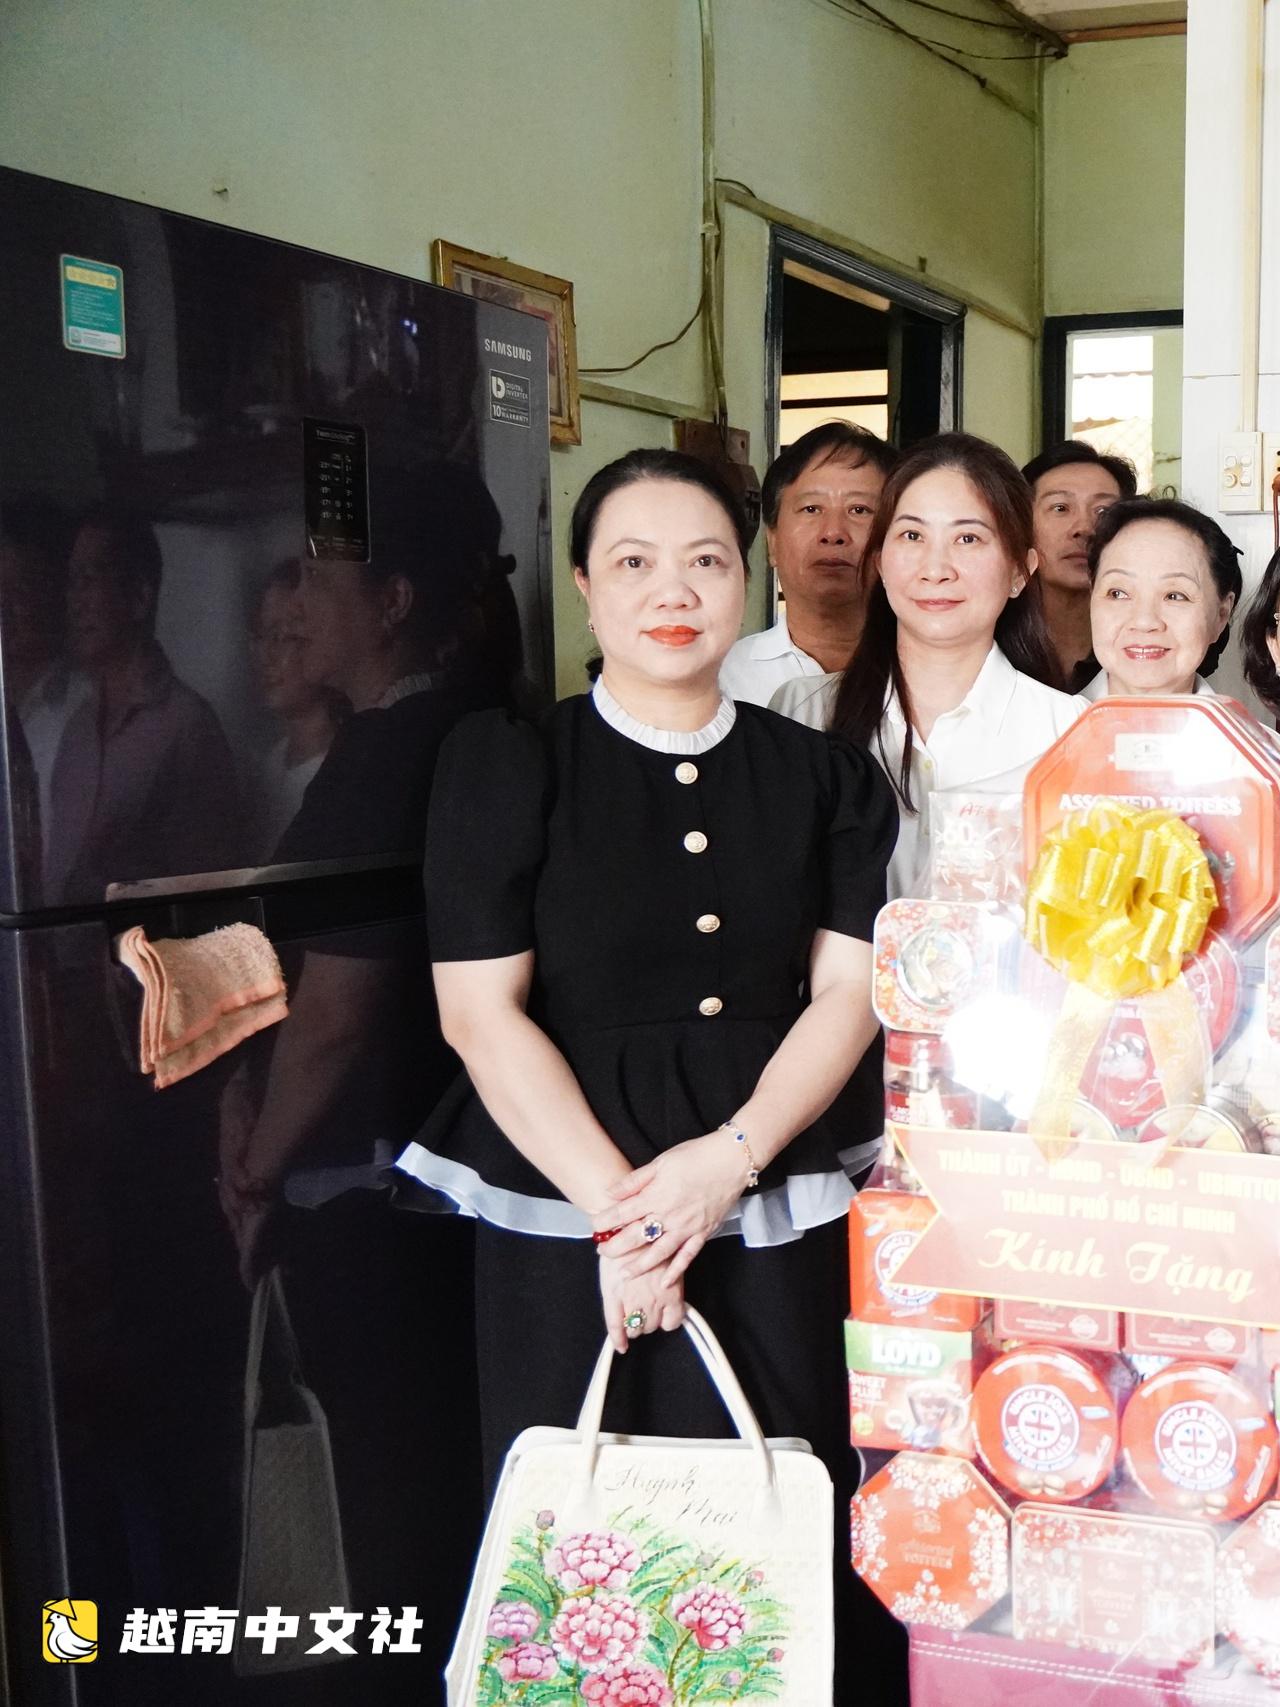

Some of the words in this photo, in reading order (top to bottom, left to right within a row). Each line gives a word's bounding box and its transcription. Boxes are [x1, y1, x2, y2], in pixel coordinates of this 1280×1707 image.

[484, 338, 532, 362] SAMSUNG
[492, 404, 502, 418] 10
[977, 1227, 1108, 1280] Kính
[1125, 1241, 1256, 1305] Tặng
[871, 1333, 942, 1368] LOYD
[1007, 1389, 1047, 1416] UNCLE
[1045, 1392, 1074, 1426] JOE'S
[1161, 1407, 1199, 1438] UNCLE
[1199, 1410, 1228, 1441] JOE'S
[1007, 1426, 1039, 1460] MINT
[1037, 1433, 1073, 1460] BALLS
[1162, 1447, 1195, 1478] MINT
[1194, 1449, 1231, 1480] BALLS
